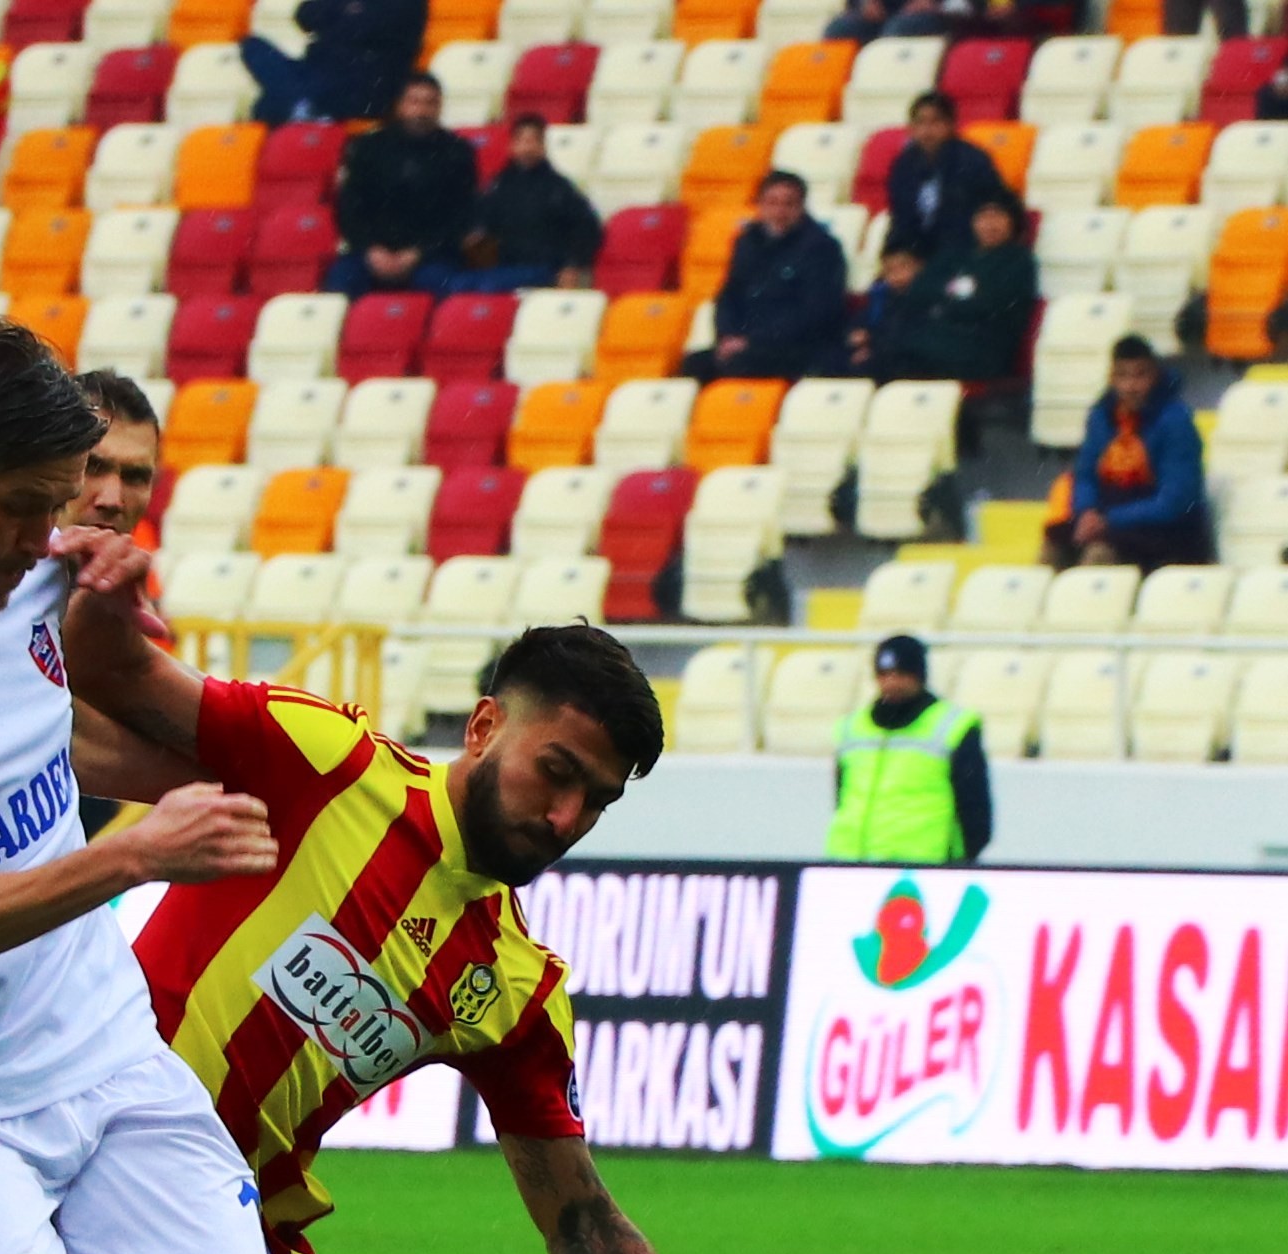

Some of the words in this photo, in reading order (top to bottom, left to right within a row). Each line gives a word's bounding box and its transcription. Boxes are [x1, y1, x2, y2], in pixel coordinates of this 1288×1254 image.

[401, 917, 434, 958] adidas
[821, 984, 986, 1118] GÜLER
[1016, 921, 1288, 1142] KASA
